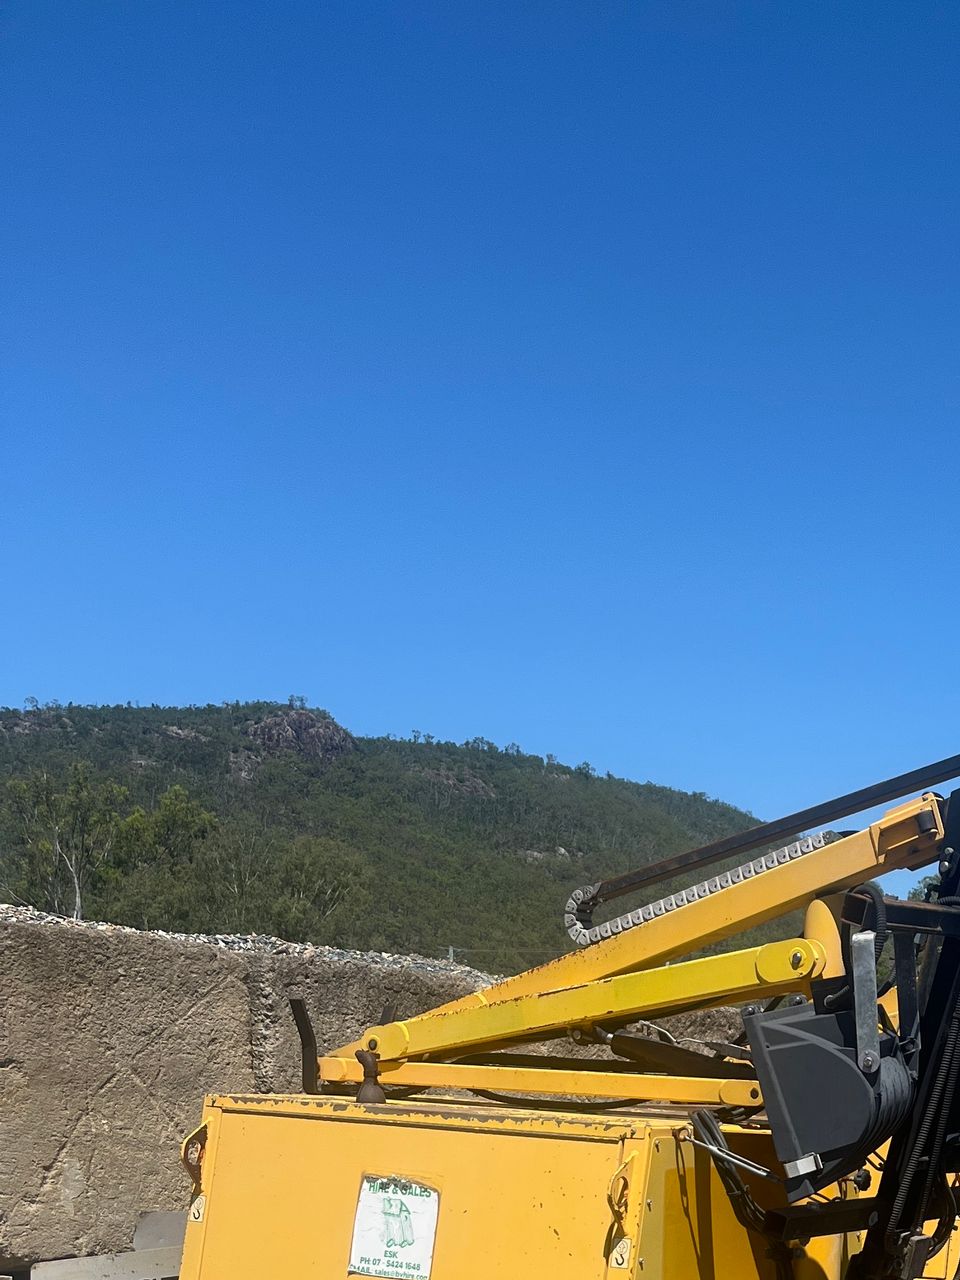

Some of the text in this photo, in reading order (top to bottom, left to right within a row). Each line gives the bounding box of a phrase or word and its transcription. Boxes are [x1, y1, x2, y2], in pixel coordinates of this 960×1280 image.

[368, 1181, 390, 1194] HIRE
[383, 1250, 398, 1259] ESK
[372, 1258, 381, 1266] 07
[386, 1259, 404, 1269] 5424
